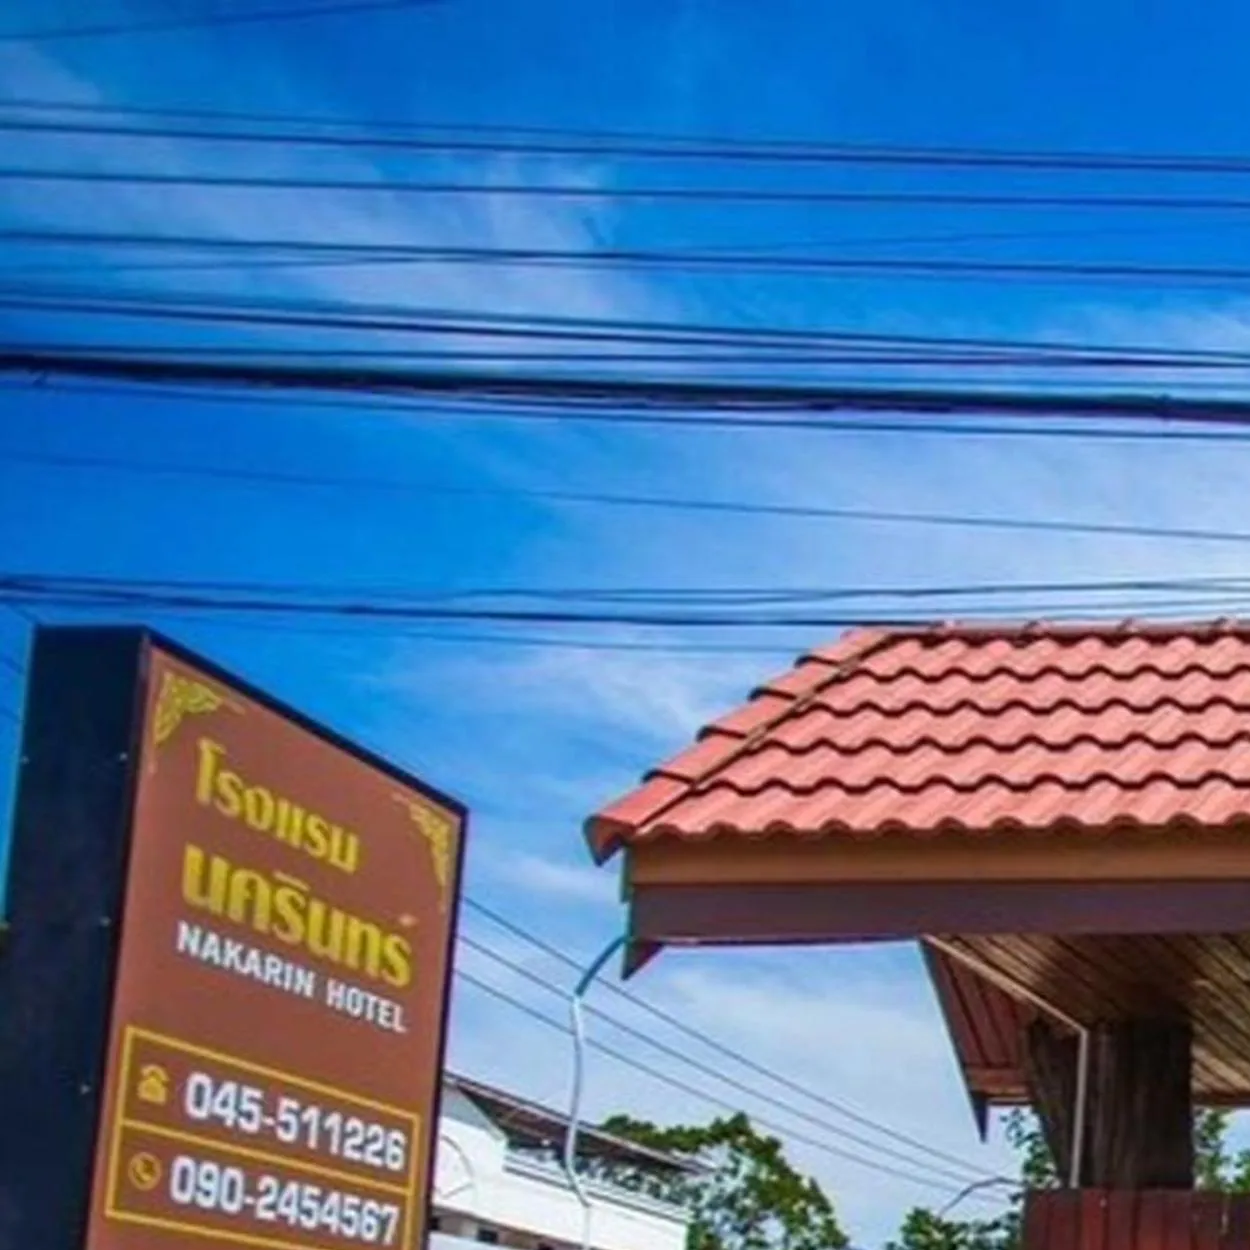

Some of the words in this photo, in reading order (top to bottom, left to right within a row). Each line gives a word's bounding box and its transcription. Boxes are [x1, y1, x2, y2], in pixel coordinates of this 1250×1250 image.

[195, 738, 359, 874] โรงแรม
[176, 920, 315, 998] NAKARIN
[325, 977, 407, 1033] HOTEL
[184, 1072, 406, 1171] 045-511226
[169, 1155, 400, 1247] 090-2454567
